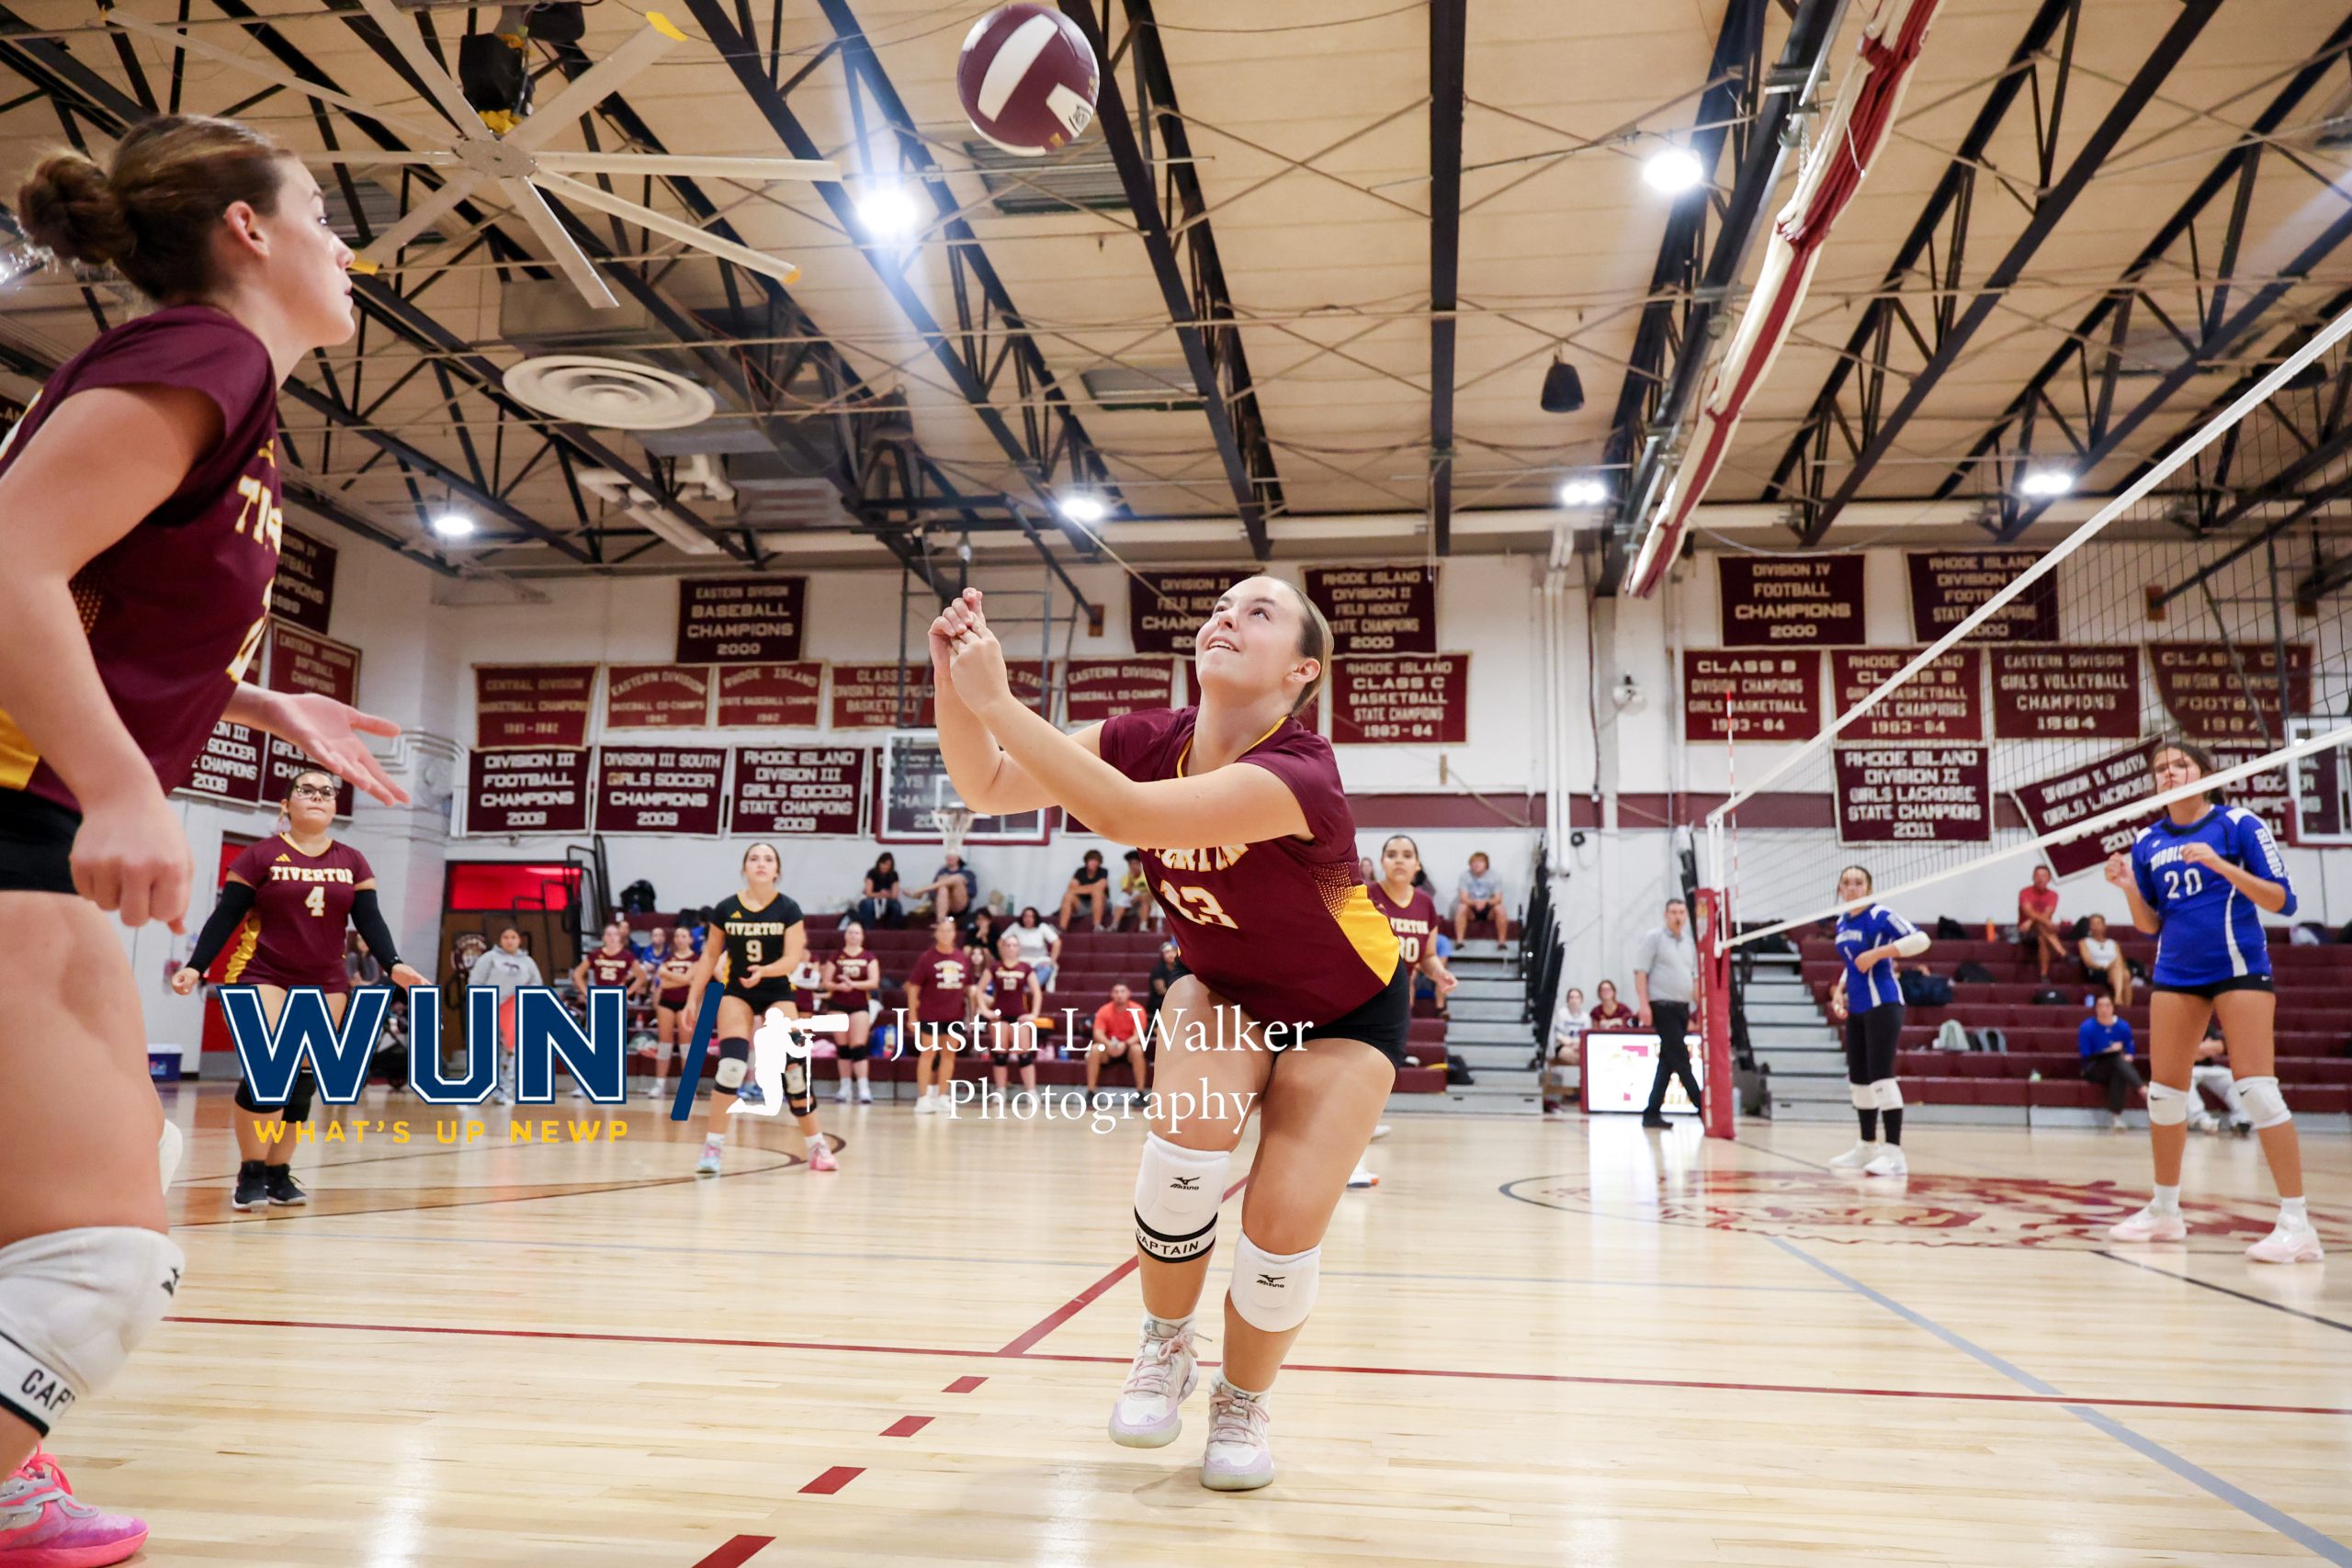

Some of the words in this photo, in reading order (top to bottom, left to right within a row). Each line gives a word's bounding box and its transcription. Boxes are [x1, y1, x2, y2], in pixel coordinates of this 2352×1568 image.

[1753, 563, 1810, 577] DIVISION
[1815, 563, 1831, 576] IV
[1930, 556, 1978, 570] RHODE
[1161, 579, 1216, 591] DIVISION
[1323, 573, 1367, 585] RHODE
[1372, 570, 1421, 583] ISLAND
[1938, 572, 2007, 586] DIVISION
[696, 588, 744, 599] EASTERN
[748, 586, 789, 597] DIVISION
[1332, 588, 1396, 601] DIVISION
[1754, 582, 1831, 597] FOOTBALL
[692, 604, 790, 618] BASEBALL
[1334, 604, 1365, 616] FIELD
[1368, 603, 1409, 615] HOCKEY
[1735, 603, 1852, 619] CHAMPIONS
[687, 623, 795, 637] CHAMPIONS
[1361, 617, 1420, 632] CHAMPIONS
[1770, 625, 1818, 638] 2000
[717, 643, 762, 656] 2000
[1350, 636, 1396, 649] 2000
[1346, 662, 1395, 675] RHODE
[1399, 661, 1453, 675] ISLAND
[1697, 660, 1774, 673] CLASS
[1849, 655, 1900, 669] RHODE
[2004, 653, 2064, 669] EASTERN
[2068, 653, 2125, 668] DIVISION
[723, 668, 762, 688] RHODE
[773, 667, 819, 688] ISLAND
[1068, 667, 1119, 684] EASTERN
[1121, 666, 1171, 681] DIVISION
[2001, 673, 2039, 691] GIRLS
[2044, 672, 2130, 690] VOLLEYBALL
[610, 671, 660, 697] EASTERN
[661, 671, 707, 695] DIVISION
[1352, 677, 1425, 691] CLASS
[1430, 677, 1445, 690] C
[1742, 678, 1804, 694] CHAMPIONS
[1349, 691, 1449, 706] BASKETBALL
[2016, 694, 2117, 711] CHAMPIONS
[1353, 707, 1385, 723] STATE
[1388, 706, 1444, 722] CHAMPIONS
[1689, 700, 1724, 714] GIRLS
[1895, 702, 1967, 717] CHAMPIONS
[207, 737, 257, 763] SOCCER
[743, 750, 797, 765] RHODE
[799, 750, 856, 766] ISLAND
[484, 753, 553, 770] DIVISION
[556, 752, 577, 767] III
[604, 752, 656, 767] DIVISION
[658, 752, 677, 768] III
[678, 753, 722, 769] SOUTH
[1845, 750, 1908, 768] RHODE
[1912, 749, 1979, 767] ISLAND
[200, 753, 258, 781] CHAMPIONS
[755, 767, 818, 782] DIVISION
[820, 767, 842, 782] III
[483, 773, 575, 788] FOOTBALL
[606, 772, 652, 786] GIRLS
[653, 773, 717, 789] SOCCER
[1864, 768, 1939, 785] DIVISION
[1942, 768, 1960, 784] II
[480, 791, 576, 808] CHAMPIONS
[609, 791, 709, 808] CHAMPIONS
[741, 783, 788, 799] GIRLS
[789, 784, 854, 800] SOCCER
[1849, 786, 1894, 805] GIRLS
[1896, 785, 1977, 803] LACROSSE
[739, 800, 780, 816] STATE
[781, 800, 854, 817] CHAMPIONS
[1848, 805, 1894, 823] STATE
[1897, 804, 1983, 821] CHAMPIONS
[1894, 821, 1935, 840] 2011
[2164, 867, 2204, 900] 20
[305, 886, 325, 918] 4
[1159, 878, 1240, 930] 13
[724, 921, 786, 937] TIVERTON
[745, 939, 763, 964] 9
